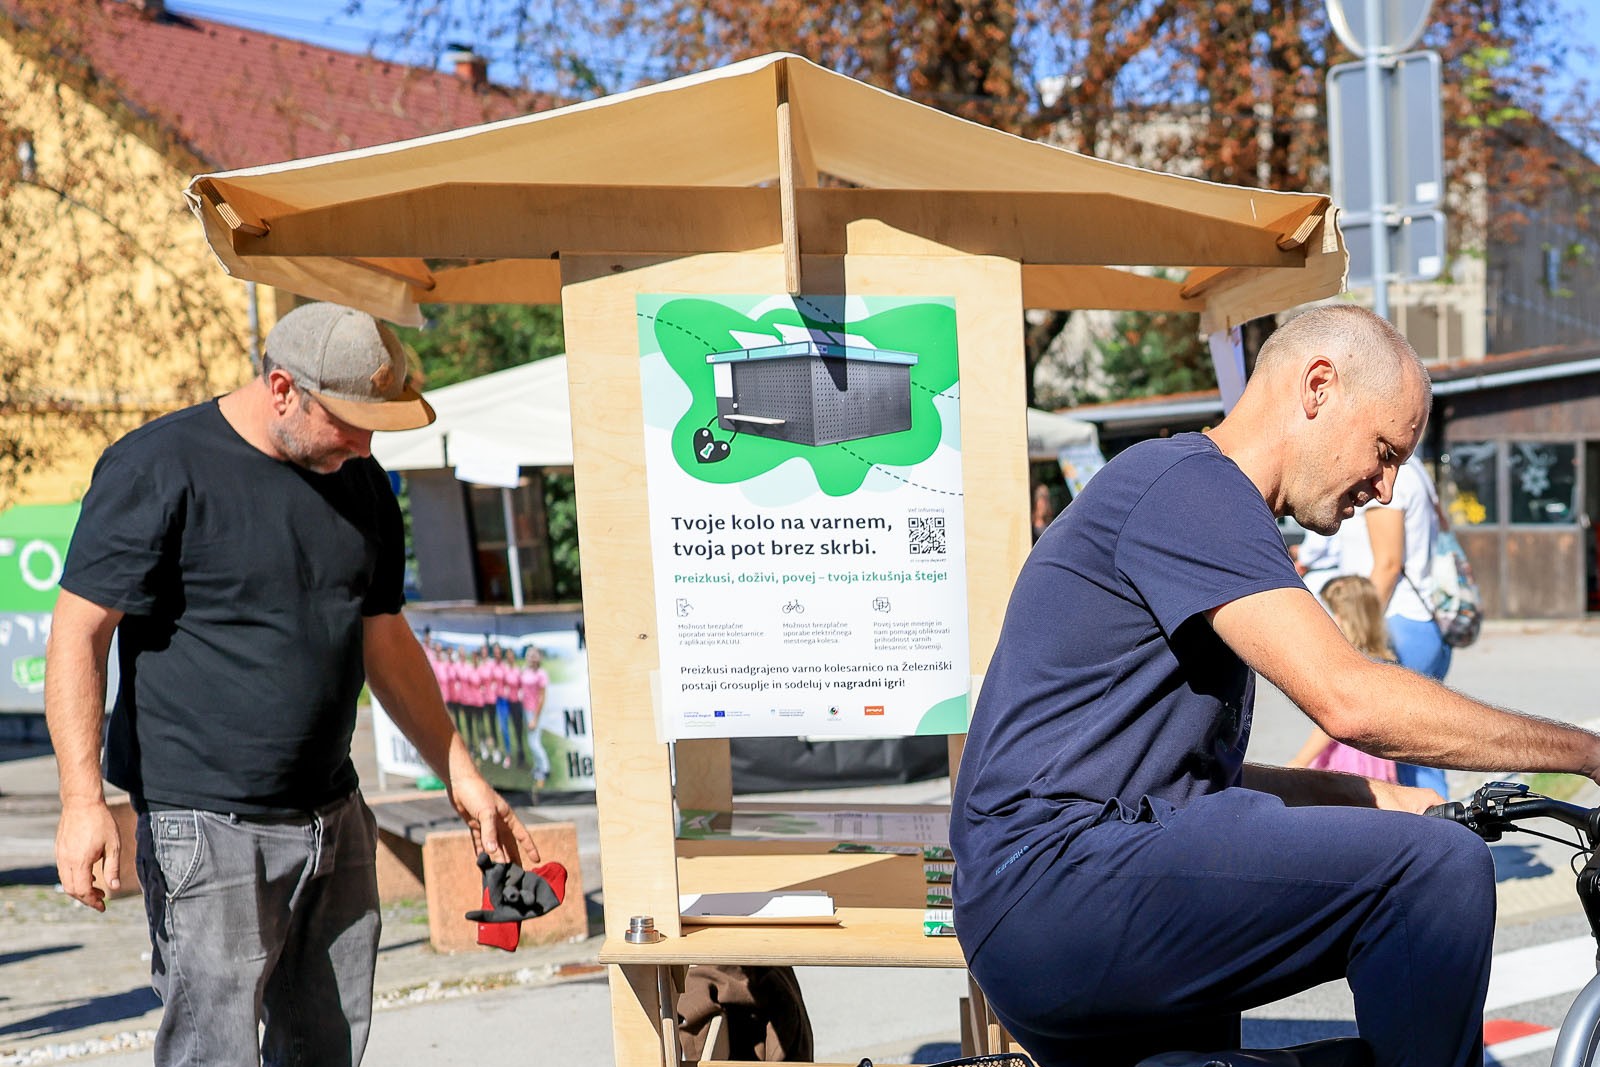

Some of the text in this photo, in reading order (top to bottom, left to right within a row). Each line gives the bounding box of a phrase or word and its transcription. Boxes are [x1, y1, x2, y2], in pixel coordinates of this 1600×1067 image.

[671, 514, 893, 535] Tvoje kolo na varnem,
[673, 538, 877, 560] tvoja pot brez skrbi.
[674, 572, 735, 584] Preizkusi,
[738, 571, 779, 584] doživi,
[782, 571, 816, 584] povej
[827, 571, 859, 584] tvoja
[862, 570, 912, 584] izkušnja
[914, 570, 948, 583] šteje!
[680, 665, 728, 674] Preizkusi
[730, 664, 790, 676] nadgrajeno
[791, 665, 822, 673] varno
[824, 662, 884, 673] kolesarnico
[901, 660, 953, 672] Železniški
[681, 680, 718, 692] postaji
[719, 679, 770, 692] Grosuplje
[772, 679, 782, 689] in
[784, 679, 822, 690] sodeluj
[833, 678, 882, 690] nagradni
[884, 677, 906, 690] igri!
